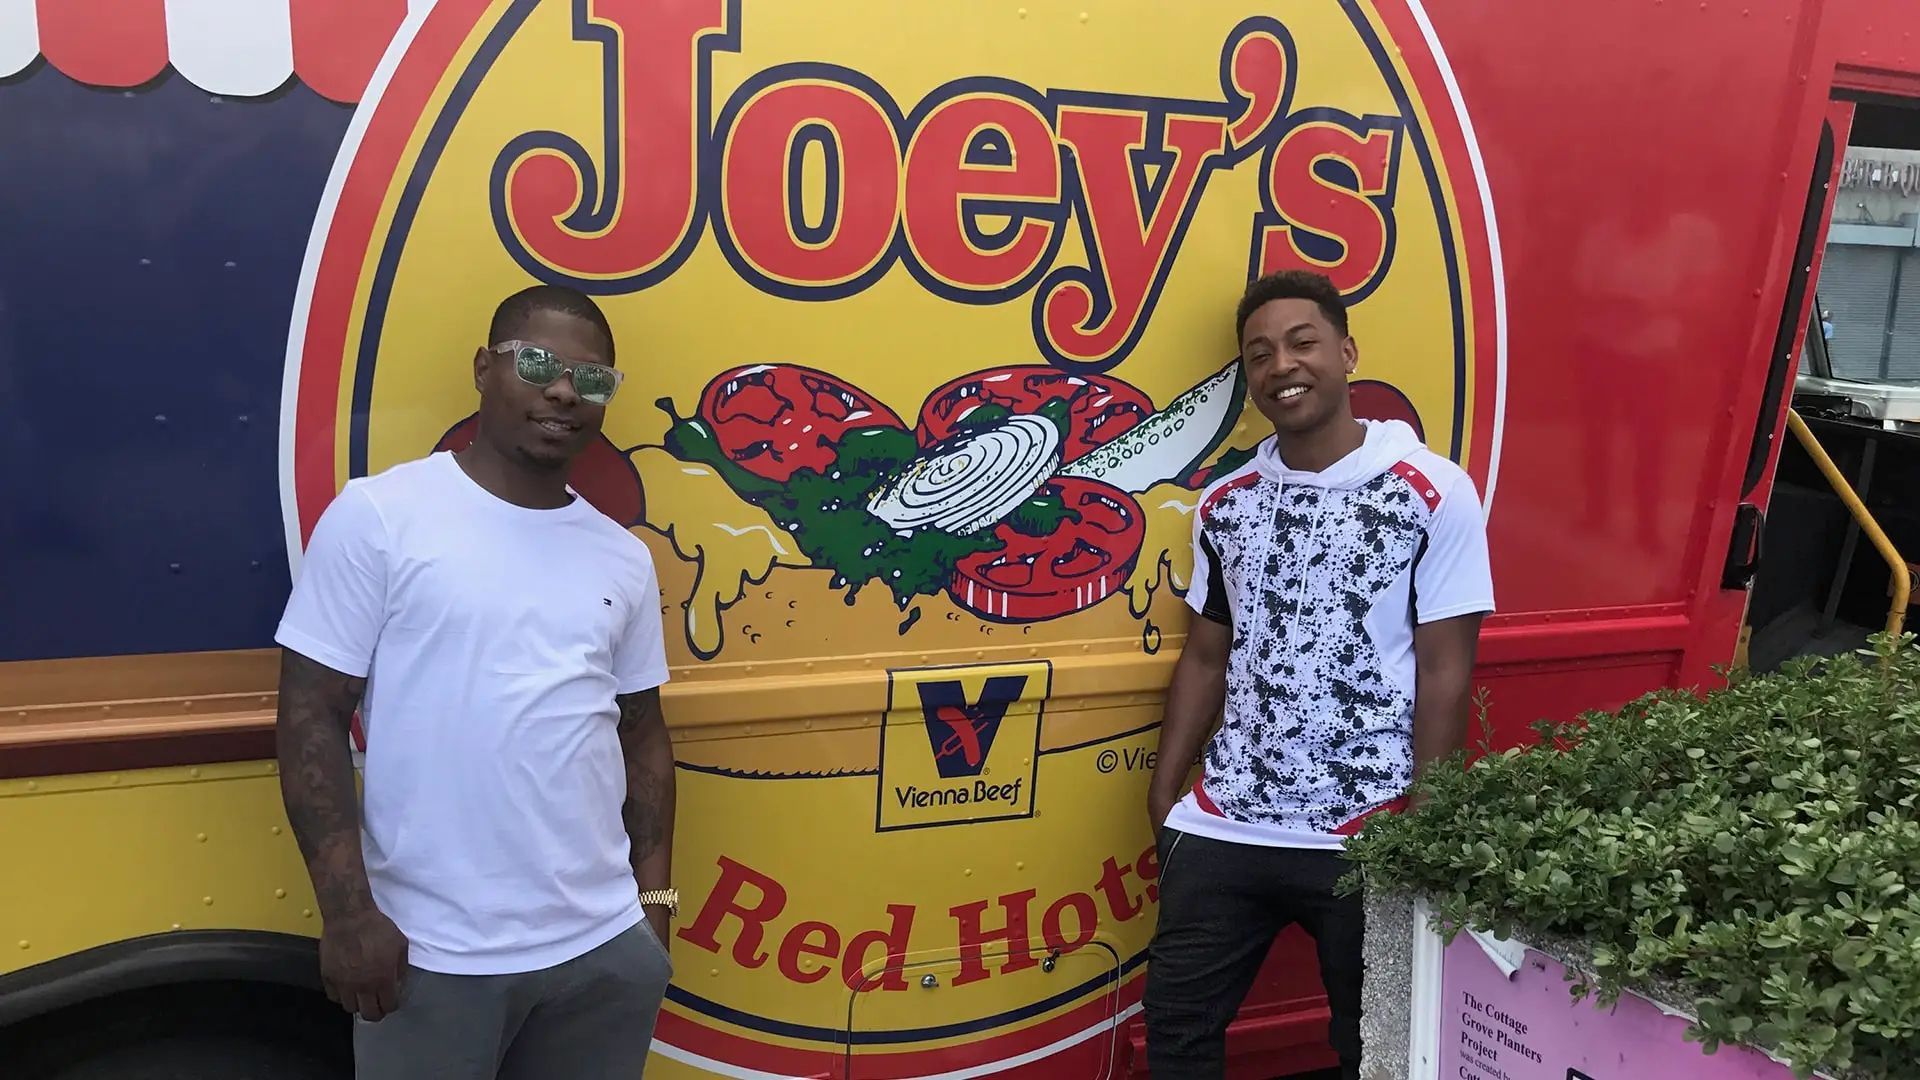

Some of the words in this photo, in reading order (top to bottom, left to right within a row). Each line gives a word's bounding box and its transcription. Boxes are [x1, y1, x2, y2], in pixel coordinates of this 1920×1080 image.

[490, 0, 1403, 373] Joey's
[895, 785, 969, 809] Vienna
[974, 777, 1023, 806] Beef
[676, 854, 917, 993] Red
[949, 845, 1160, 987] Hots
[1462, 991, 1483, 1012] The
[1485, 1003, 1528, 1035] Cottage
[1460, 1031, 1498, 1062] Project
[1461, 1012, 1494, 1039] Grove
[1496, 1029, 1542, 1064] Planters
[1460, 1049, 1474, 1064] was
[1474, 1059, 1502, 1080] created
